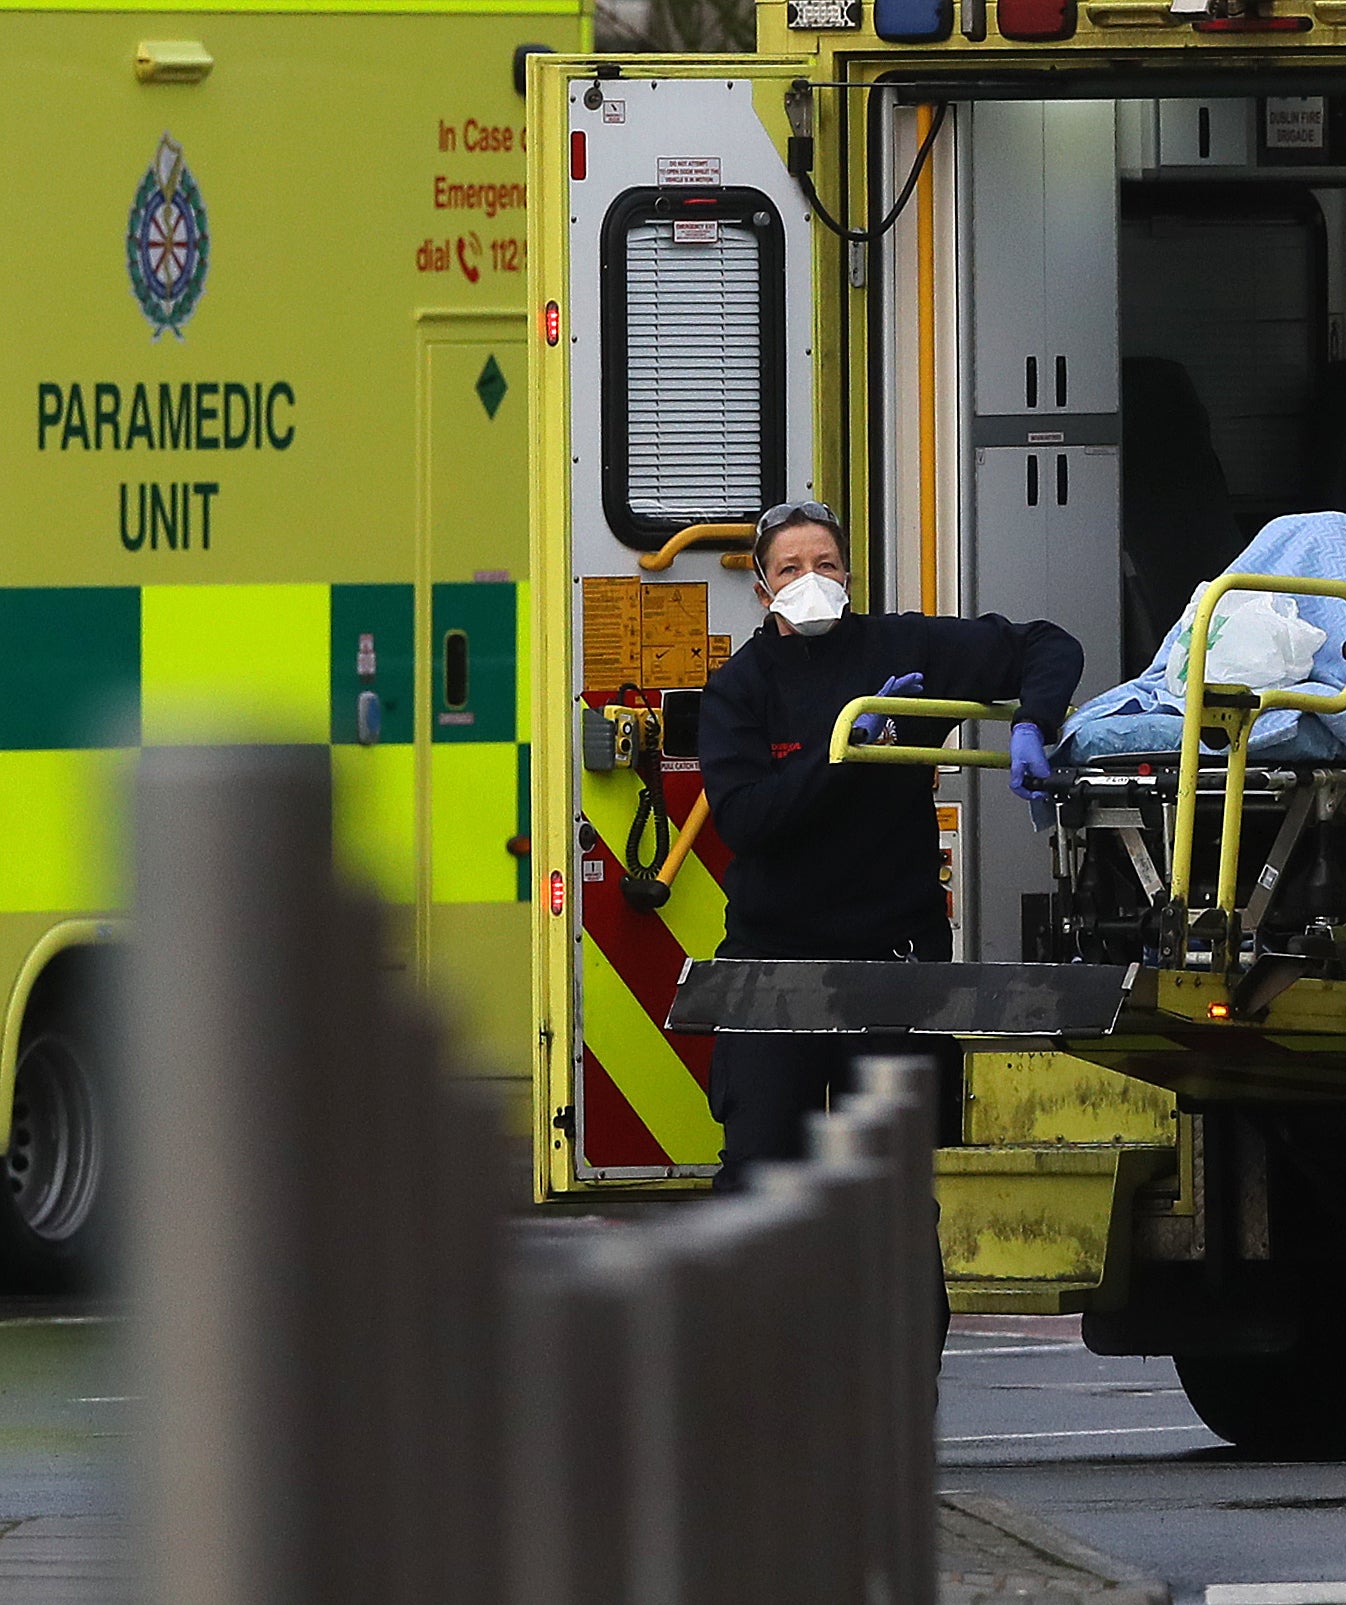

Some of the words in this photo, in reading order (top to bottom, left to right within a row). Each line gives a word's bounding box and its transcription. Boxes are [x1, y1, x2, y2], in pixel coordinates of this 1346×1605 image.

[1270, 111, 1299, 124] DUBLIN
[1300, 111, 1321, 124] FIRE
[439, 119, 457, 152] In
[464, 118, 514, 152] Case
[1277, 129, 1315, 142] BRIGADE
[434, 175, 527, 219] Emergen
[416, 238, 450, 272] dial
[38, 381, 296, 450] PARAMEDIC
[120, 482, 220, 552] UNIT
